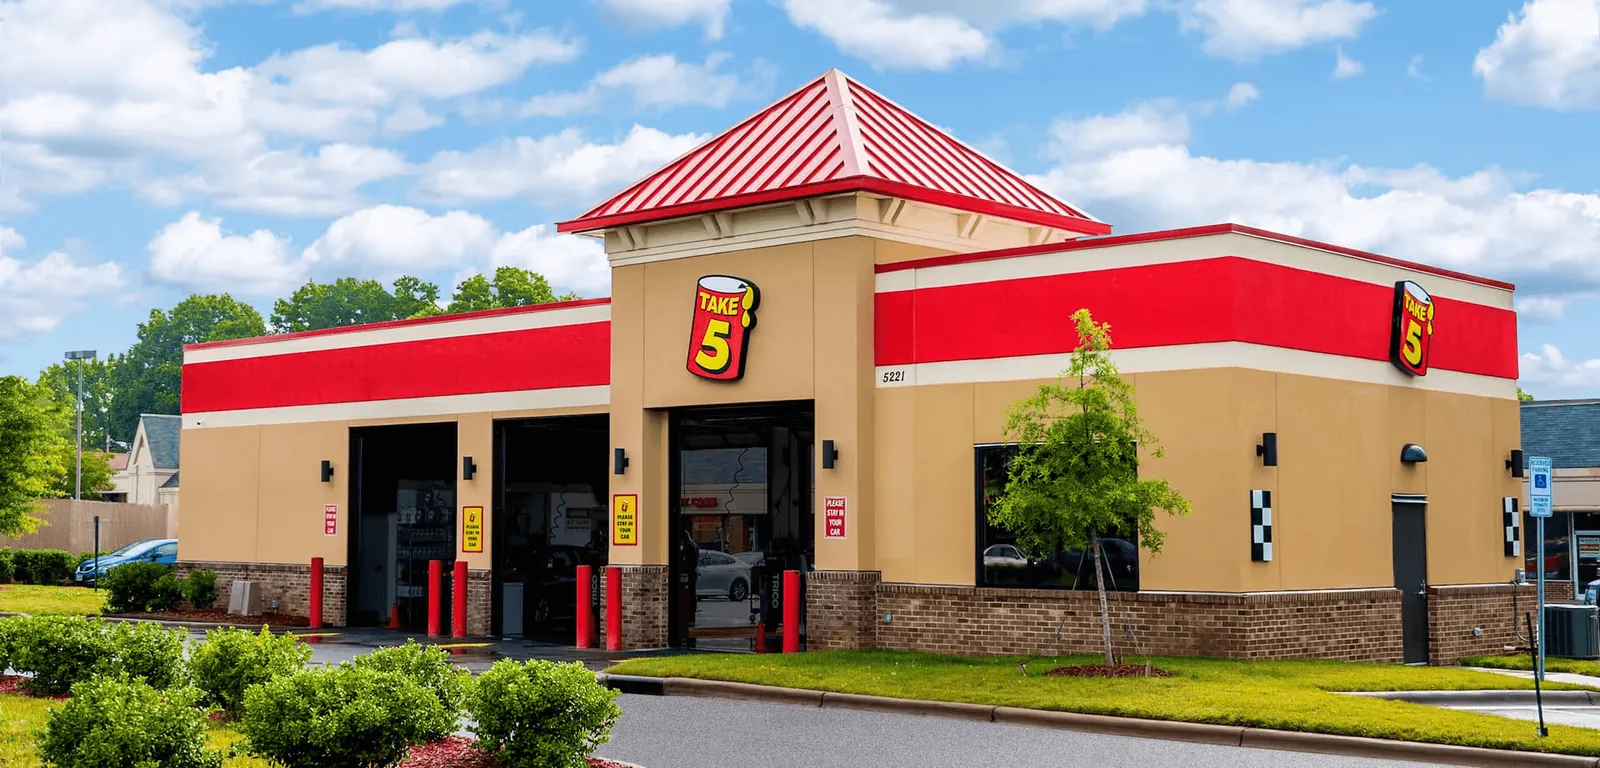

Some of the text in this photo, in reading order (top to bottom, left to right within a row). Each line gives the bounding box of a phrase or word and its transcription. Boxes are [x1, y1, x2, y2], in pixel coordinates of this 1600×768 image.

[700, 292, 739, 315] TAKE
[1404, 293, 1427, 322] TAKE
[694, 318, 730, 371] 5
[1402, 319, 1422, 366] 5
[882, 370, 905, 382] 5221
